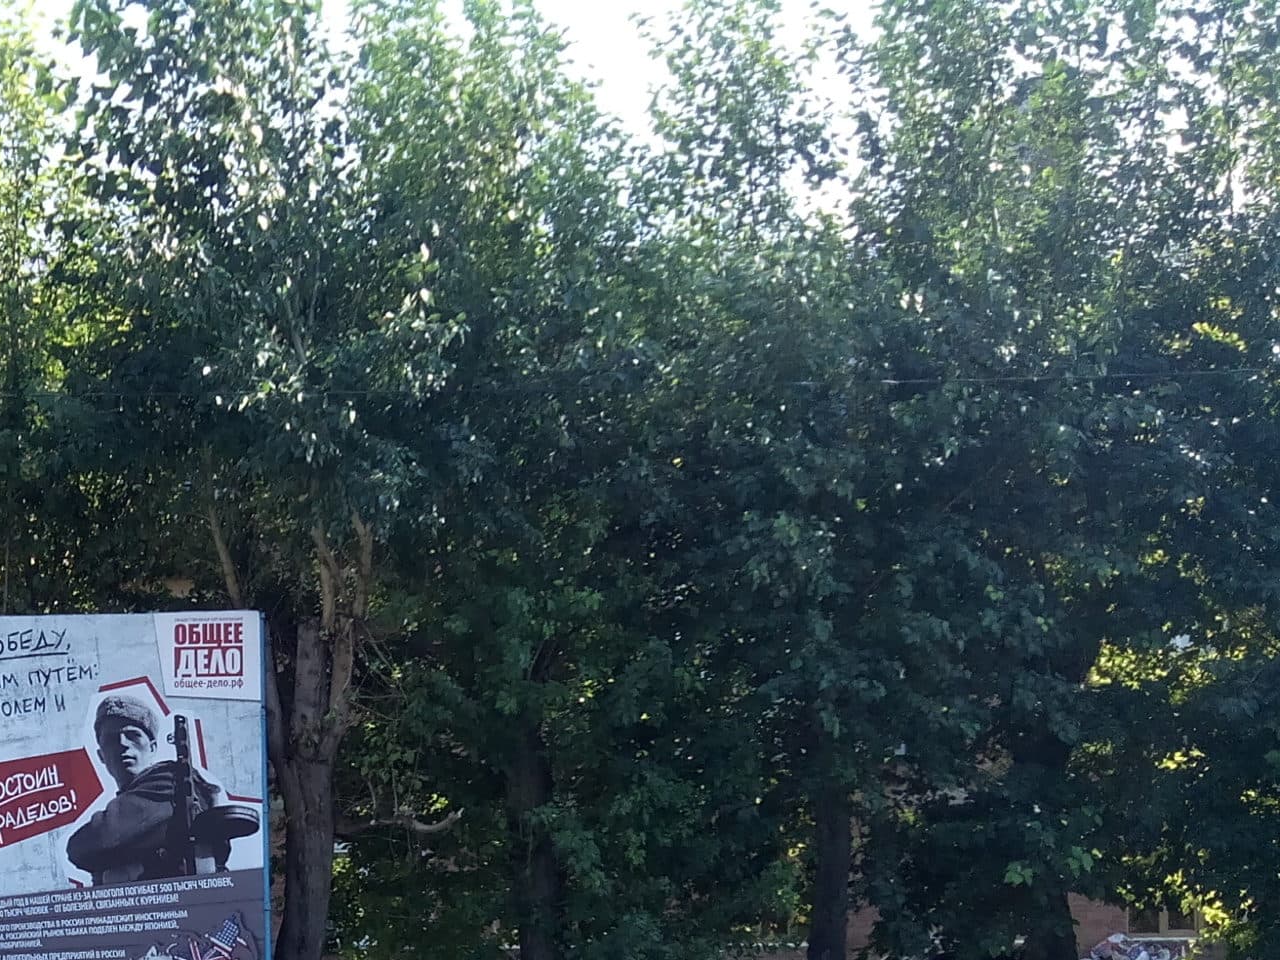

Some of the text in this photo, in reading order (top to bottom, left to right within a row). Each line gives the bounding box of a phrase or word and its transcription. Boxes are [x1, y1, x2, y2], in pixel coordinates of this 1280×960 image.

[174, 622, 243, 645] ОБЩЕЕ
[28, 658, 99, 687] ПУТЁМ:
[176, 648, 242, 677] ДЕЛО
[174, 678, 244, 689] общее-дело.рф
[55, 694, 66, 712] И
[13, 898, 25, 908] ГОД
[51, 892, 73, 902] СТРАНЕ
[73, 890, 91, 900] ИЗ-ЗА
[125, 884, 158, 895] ПОГИБАЕТ
[160, 882, 173, 892] 500
[173, 880, 198, 891] ТЫСЯЧ
[198, 877, 234, 888] ЧЕЛОВЕК,
[4, 908, 23, 917] ТЫСЯЧ
[24, 906, 49, 915] ЧЕЛОВЕК
[54, 904, 61, 913] ОТ
[96, 898, 134, 909] СВЯЗАННЫХ
[135, 897, 140, 906] С
[61, 918, 84, 927] РОССИИ
[85, 914, 133, 926] ПРИНАДЛЕЖИТ
[134, 910, 188, 921] ИНОСТРАННЫМ
[43, 928, 64, 938] РЫНОК
[65, 927, 88, 936] ТАБАКА
[89, 925, 118, 935] ПОДЕЛЕН
[119, 923, 143, 932] МЕЖДУ
[144, 920, 179, 931] ЯПОНИЕЙ,
